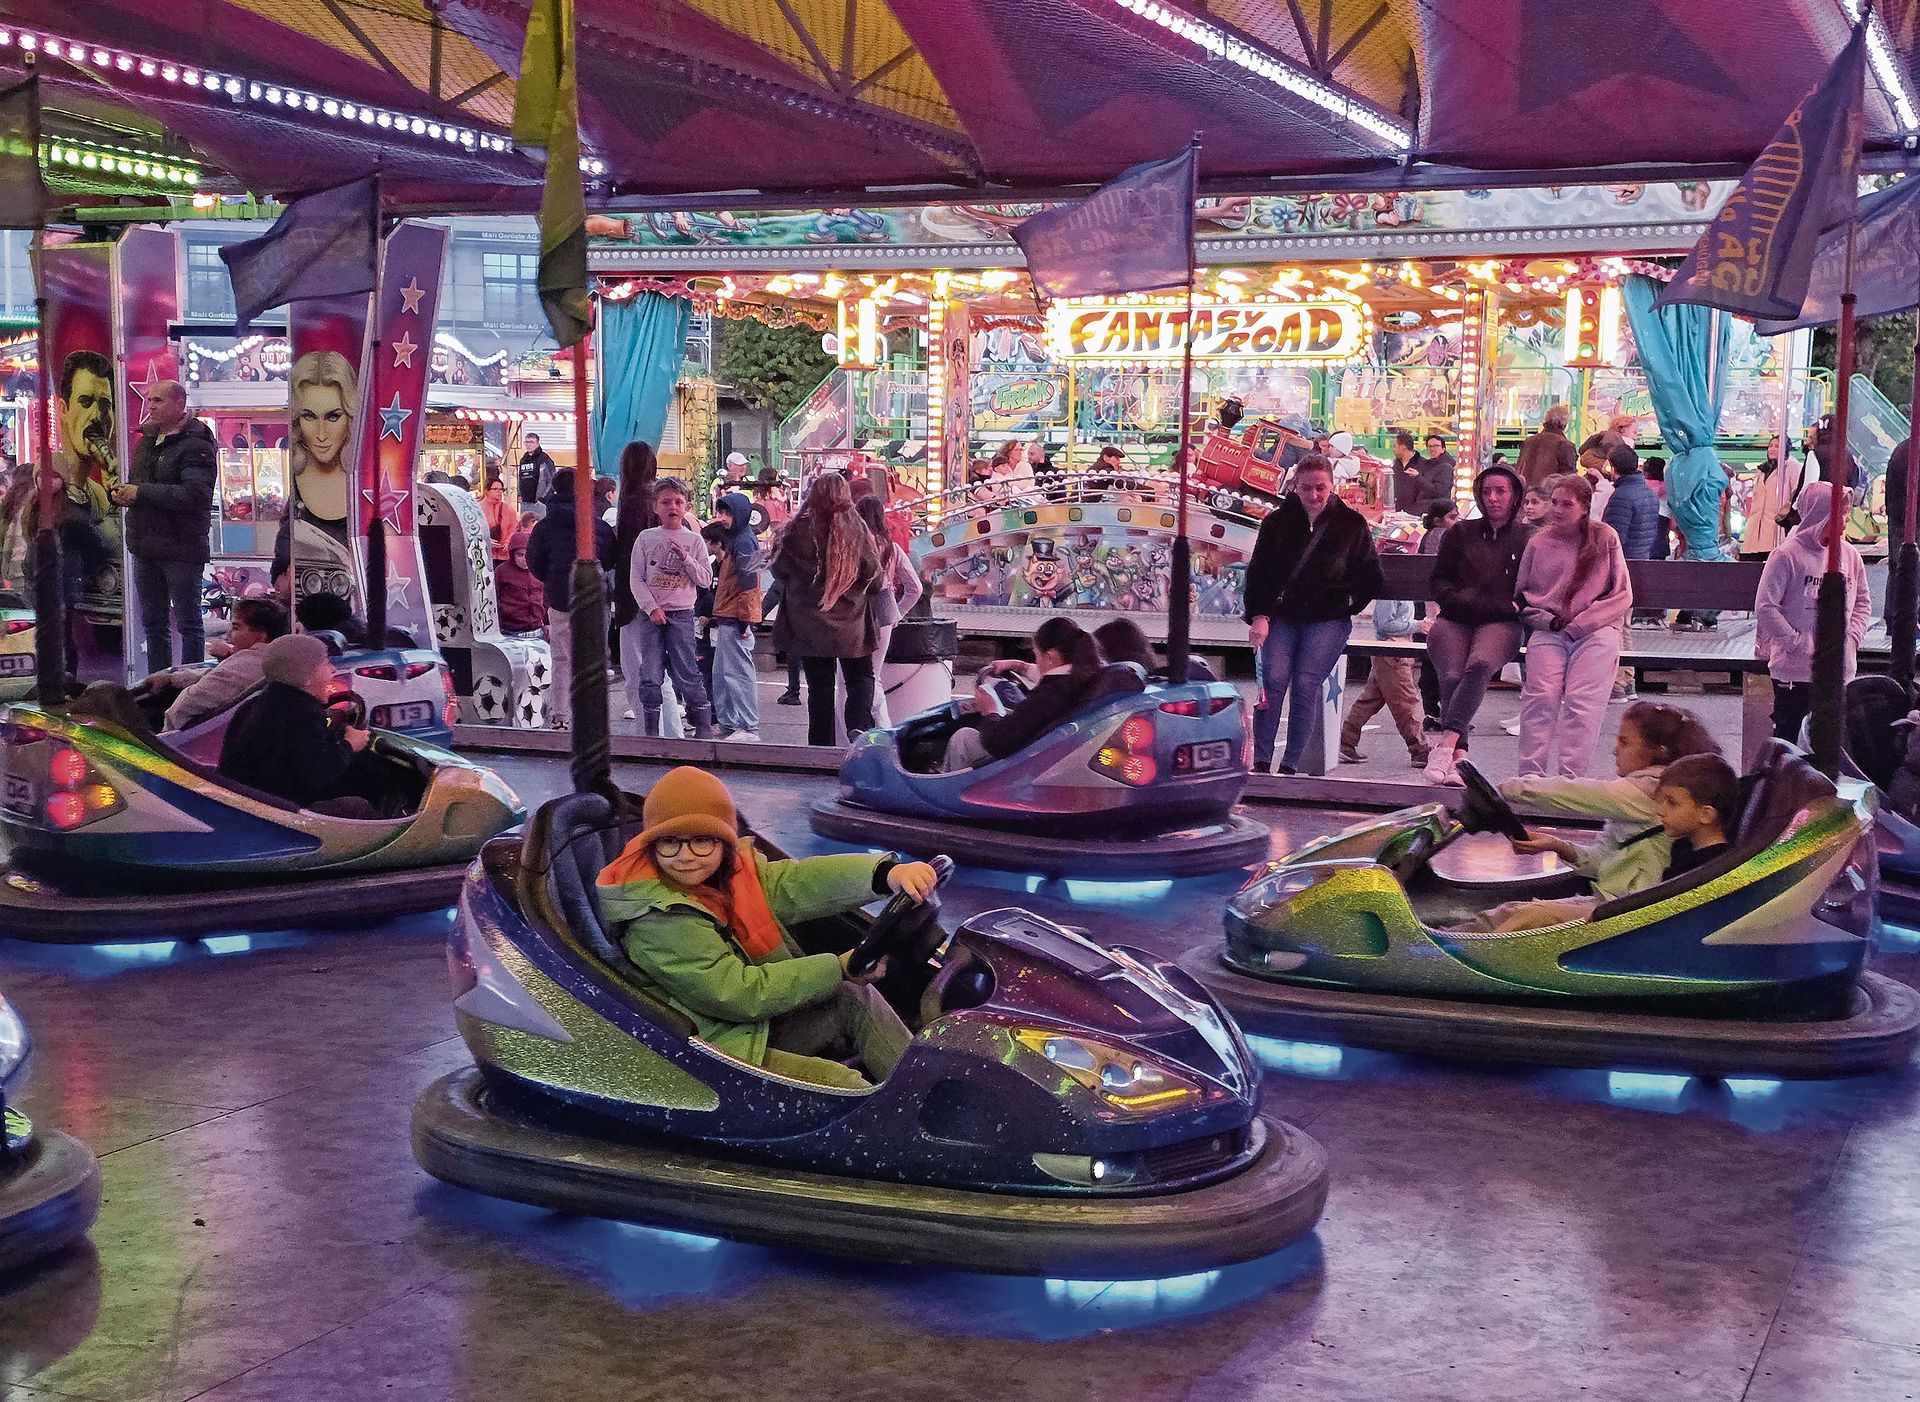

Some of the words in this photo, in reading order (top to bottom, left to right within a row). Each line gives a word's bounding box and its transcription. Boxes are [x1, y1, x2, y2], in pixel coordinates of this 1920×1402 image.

[1712, 231, 1745, 294] AG
[1069, 309, 1268, 354] FANTASY
[1206, 308, 1343, 354] ROAD
[401, 707, 420, 720] 13
